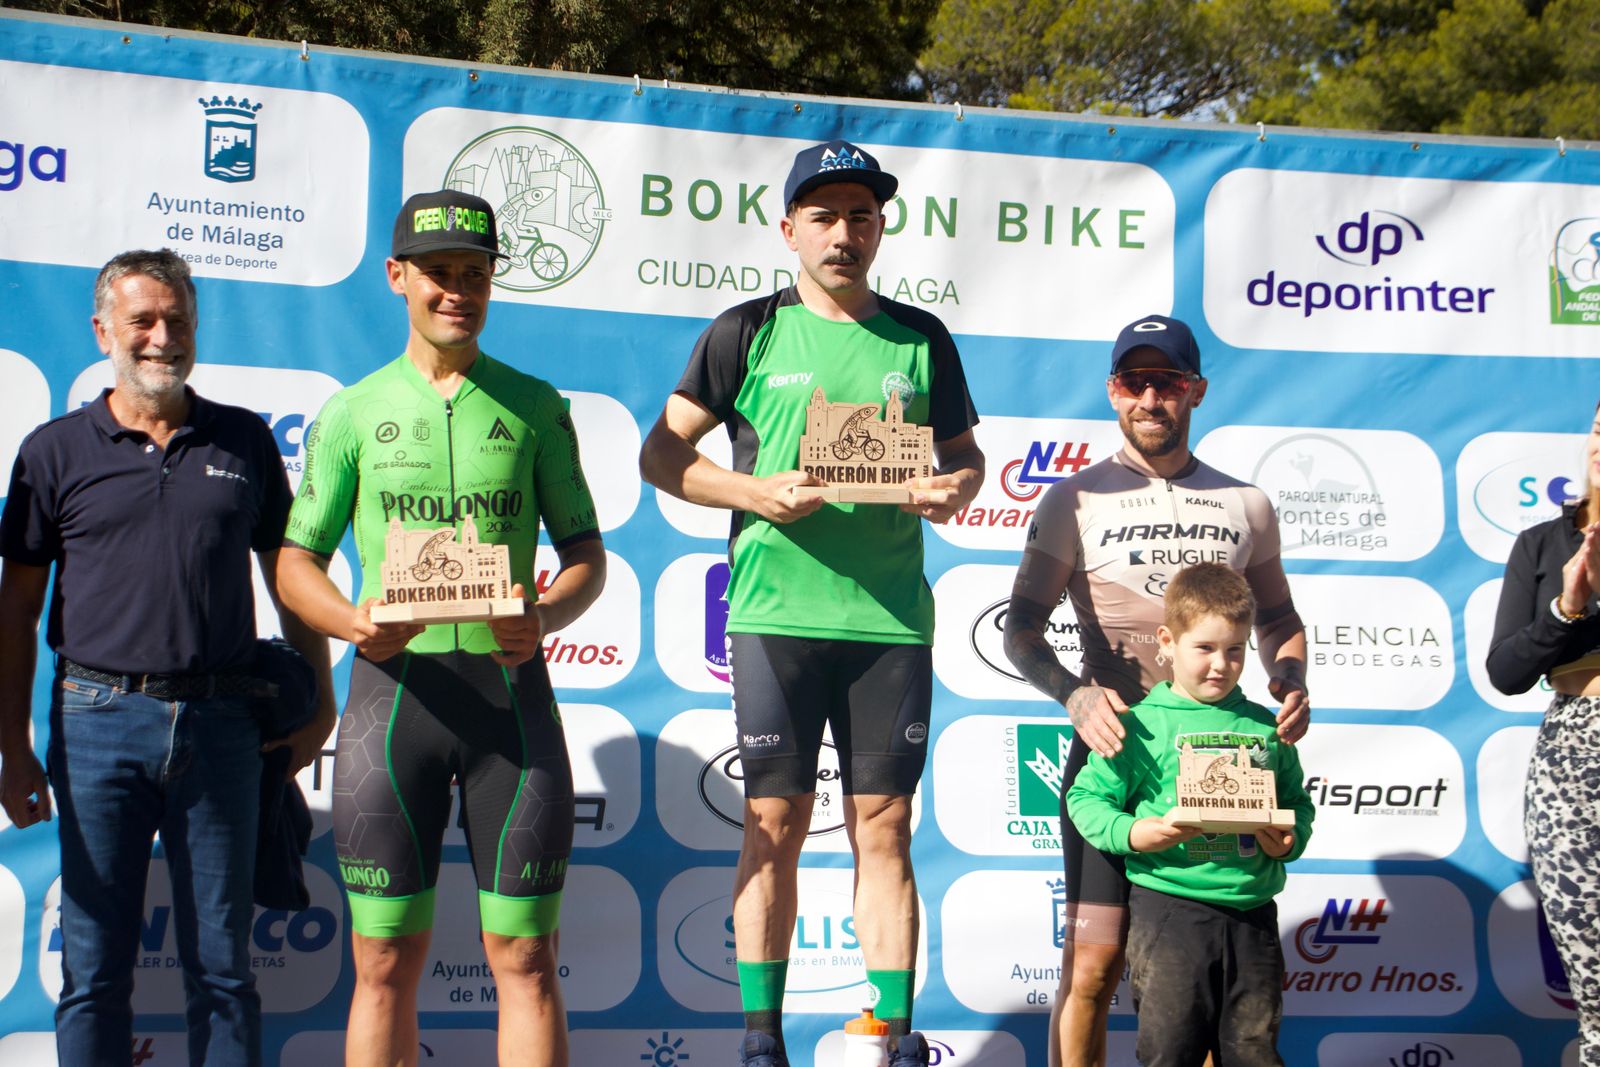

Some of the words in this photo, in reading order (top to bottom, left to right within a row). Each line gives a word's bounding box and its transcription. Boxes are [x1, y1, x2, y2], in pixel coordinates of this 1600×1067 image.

[0, 139, 67, 191] ga
[821, 157, 867, 168] CYCLE
[147, 192, 305, 223] Ayuntamiento
[593, 210, 613, 219] MLG
[414, 207, 447, 233] GREEN
[455, 207, 488, 235] POWER
[998, 201, 1145, 249] BIKE
[167, 223, 194, 242] de
[202, 225, 284, 252] Málaga
[1338, 211, 1403, 265] dp
[205, 253, 221, 265] de
[225, 254, 278, 269] Deporte
[638, 258, 762, 292] CIUDAD
[1247, 271, 1495, 317] deporinter
[768, 372, 813, 389] Kenny
[379, 489, 523, 523] PROLONGO
[1120, 496, 1157, 509] GOBIK
[1185, 497, 1225, 509] KAKUL
[1279, 490, 1327, 503] PARQUE
[1329, 492, 1385, 505] NATURAL
[1359, 509, 1387, 528] de
[1100, 523, 1240, 547] HARMAN
[1301, 528, 1388, 551] Málaga
[386, 582, 457, 604] BOKERÓN
[461, 583, 495, 600] BIKE
[1304, 625, 1440, 647] LENCIA
[1315, 652, 1443, 668] BODEGAS
[1177, 734, 1266, 750] MINECRAFT
[1004, 727, 1017, 816] fundación
[1238, 798, 1264, 810] BIKE
[1304, 776, 1448, 815] fisport
[1007, 820, 1053, 836] CAJA
[811, 957, 826, 966] en
[831, 955, 864, 967] BMW
[1282, 970, 1362, 992] varro
[1370, 965, 1463, 992] Hnos.
[449, 986, 473, 1003] de
[1026, 989, 1048, 1005] de
